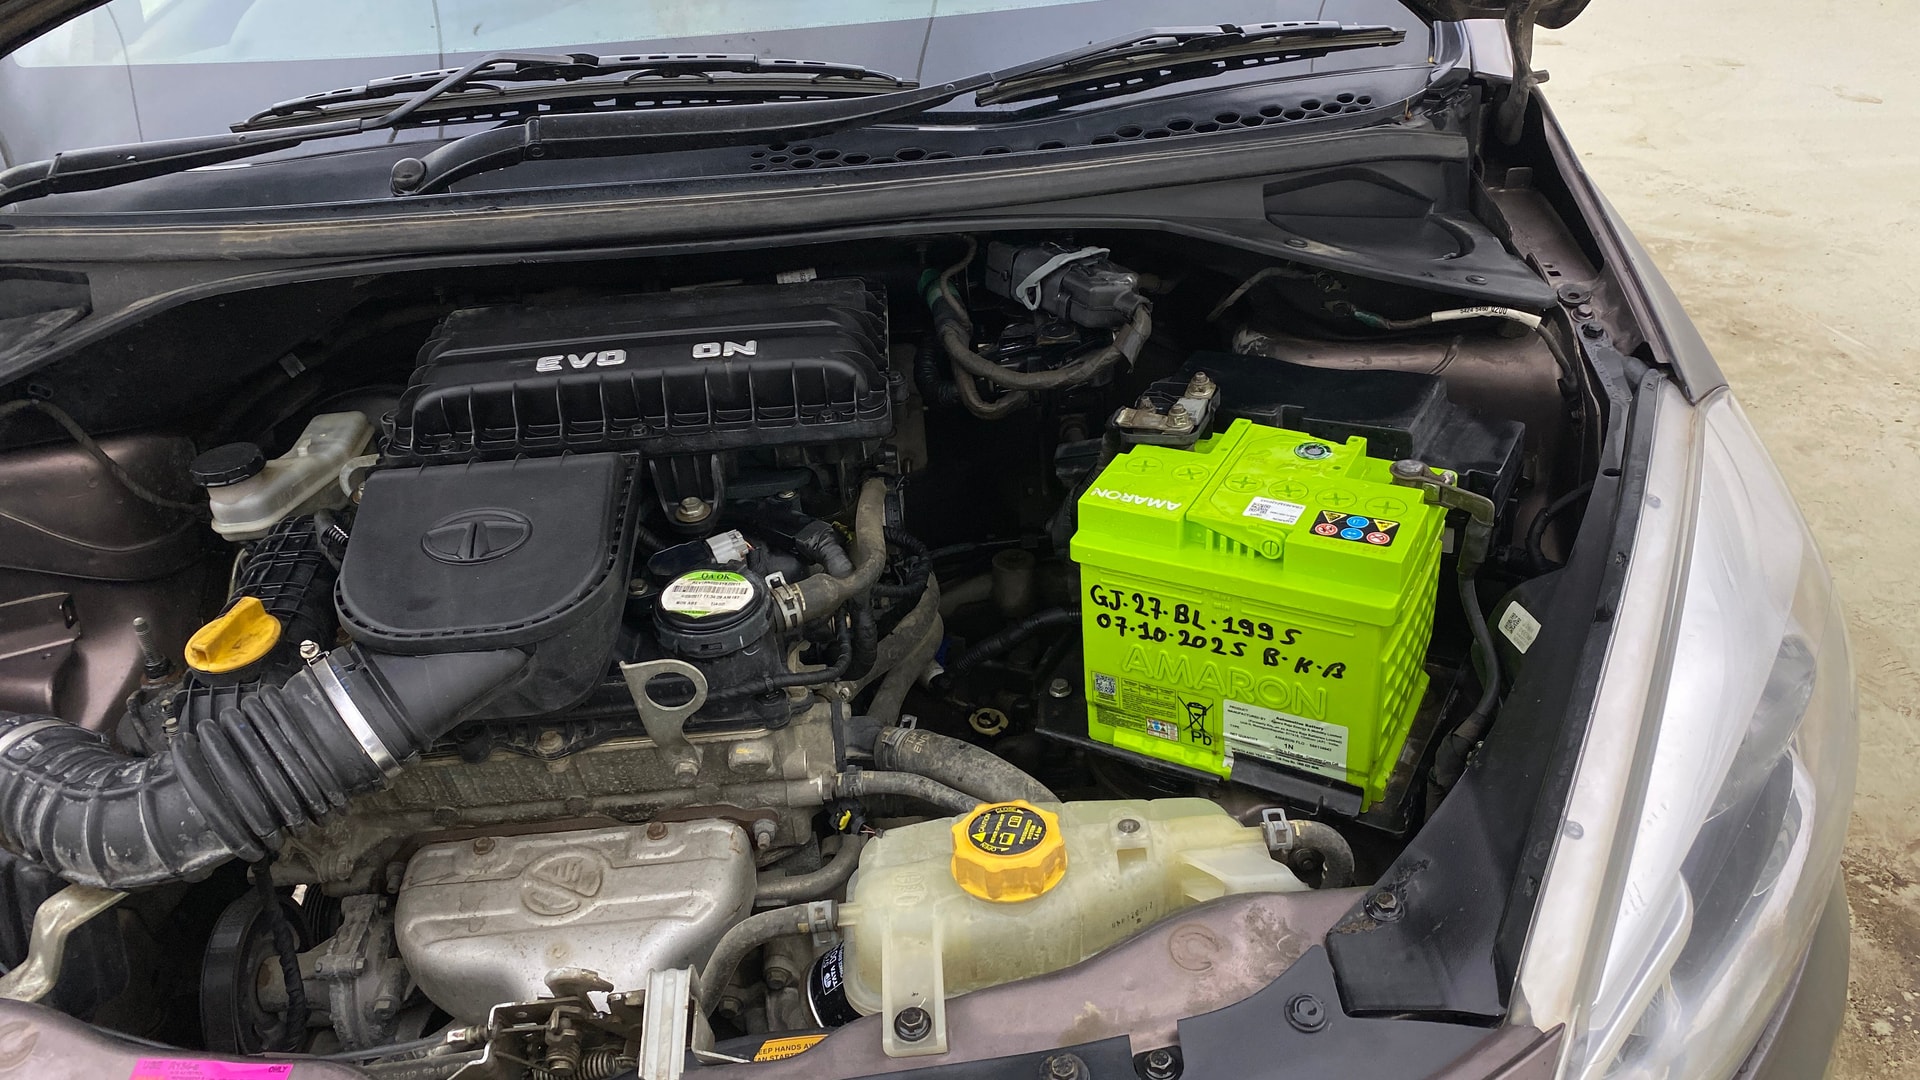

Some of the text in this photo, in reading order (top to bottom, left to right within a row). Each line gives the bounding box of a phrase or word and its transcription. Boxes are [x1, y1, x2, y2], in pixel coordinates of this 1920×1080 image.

[535, 340, 758, 372] EVO ON
[1090, 487, 1182, 511] AMARON
[701, 572, 731, 580] QA OK
[1121, 643, 1327, 720] AMARON
[1191, 730, 1212, 746] Pb
[978, 814, 991, 832] CAUTION
[774, 1044, 802, 1052] HANDS
